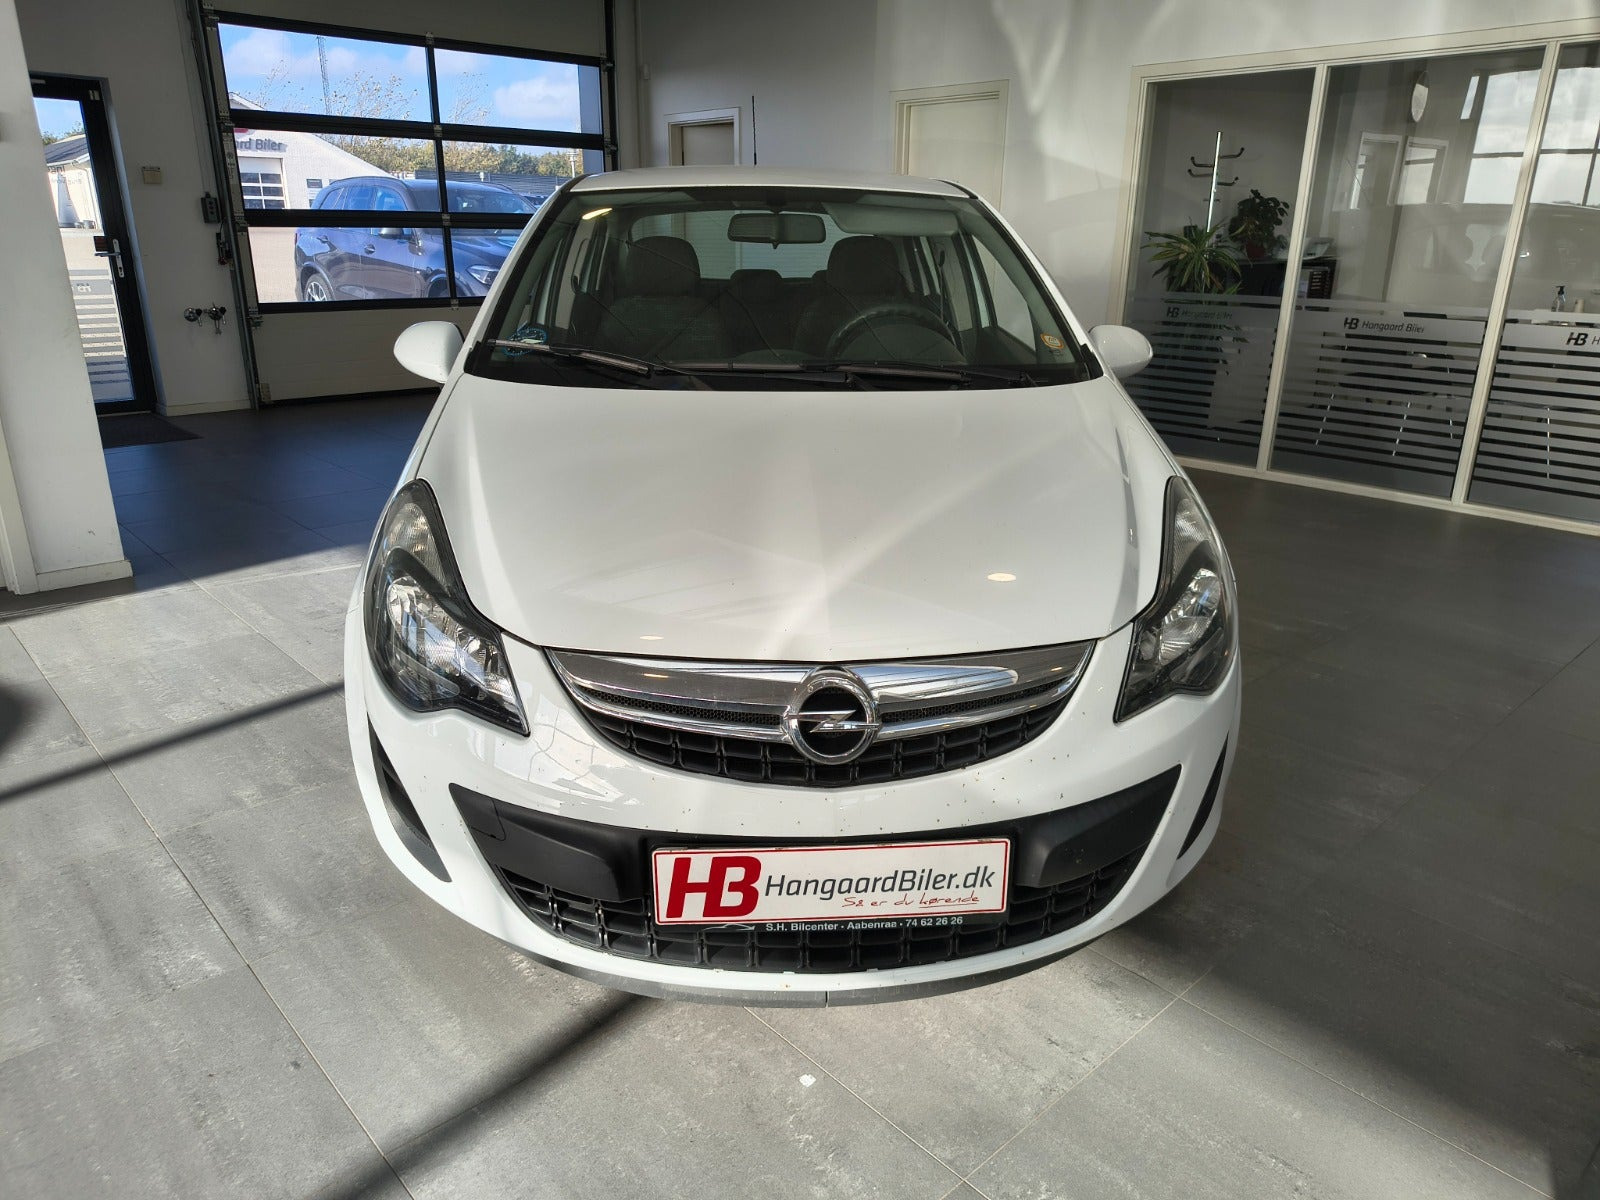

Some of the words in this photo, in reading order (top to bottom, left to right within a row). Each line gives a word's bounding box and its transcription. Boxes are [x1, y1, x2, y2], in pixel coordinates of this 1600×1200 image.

[255, 138, 283, 150] Biler
[1167, 307, 1180, 318] HB
[1344, 317, 1359, 330] HB
[1566, 332, 1588, 346] HB
[666, 856, 762, 918] HB
[765, 866, 996, 901] HangaardBiler.dk
[765, 923, 788, 932] S.H.
[791, 922, 839, 932] Bilcenter
[847, 921, 897, 930] Aabenraa
[905, 919, 918, 928] 74
[920, 918, 933, 927] 62
[936, 917, 948, 926] 26
[950, 916, 963, 925] 26
